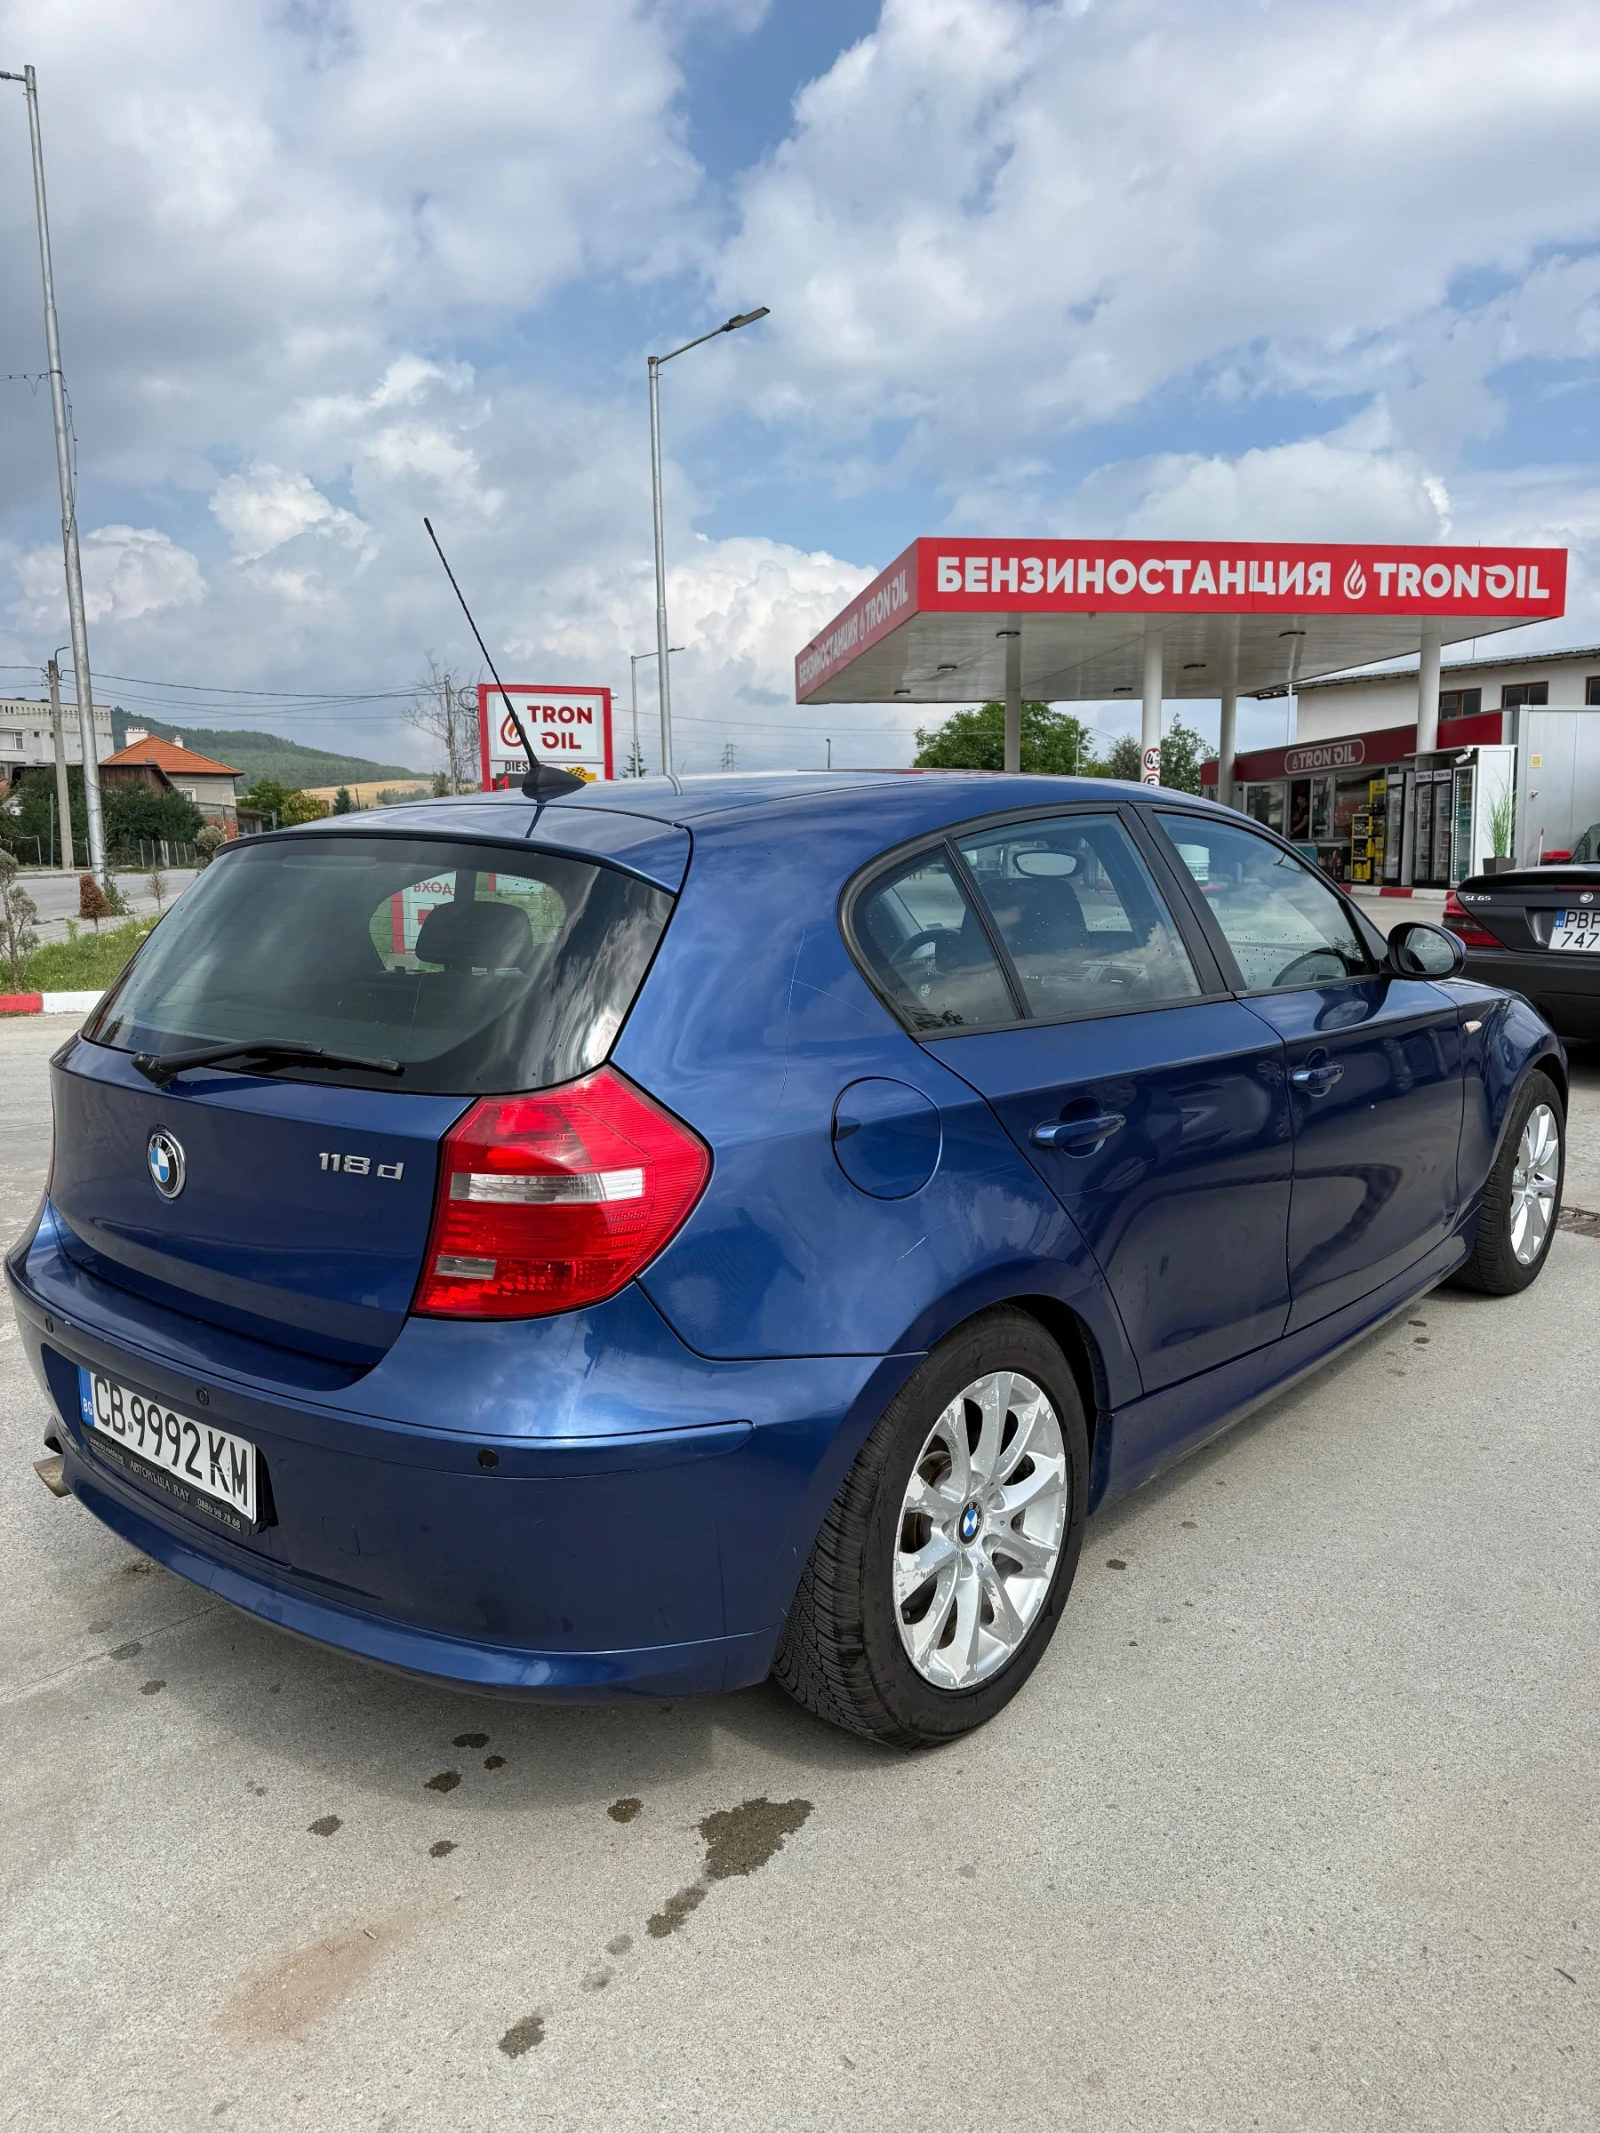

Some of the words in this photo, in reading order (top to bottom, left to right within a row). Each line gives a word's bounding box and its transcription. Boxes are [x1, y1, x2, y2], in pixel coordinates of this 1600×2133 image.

[937, 556, 1331, 596] БЕНЗИНОСТАНЦИЯ
[865, 583, 891, 633] TRON
[527, 705, 592, 724] TRON
[540, 731, 582, 750] OIL
[1299, 748, 1331, 768] TRON
[1333, 744, 1356, 764] OIL
[505, 761, 529, 773] DIES
[413, 882, 452, 895] ВХОД
[82, 1397, 93, 1416] BG
[173, 1484, 190, 1501] RAY
